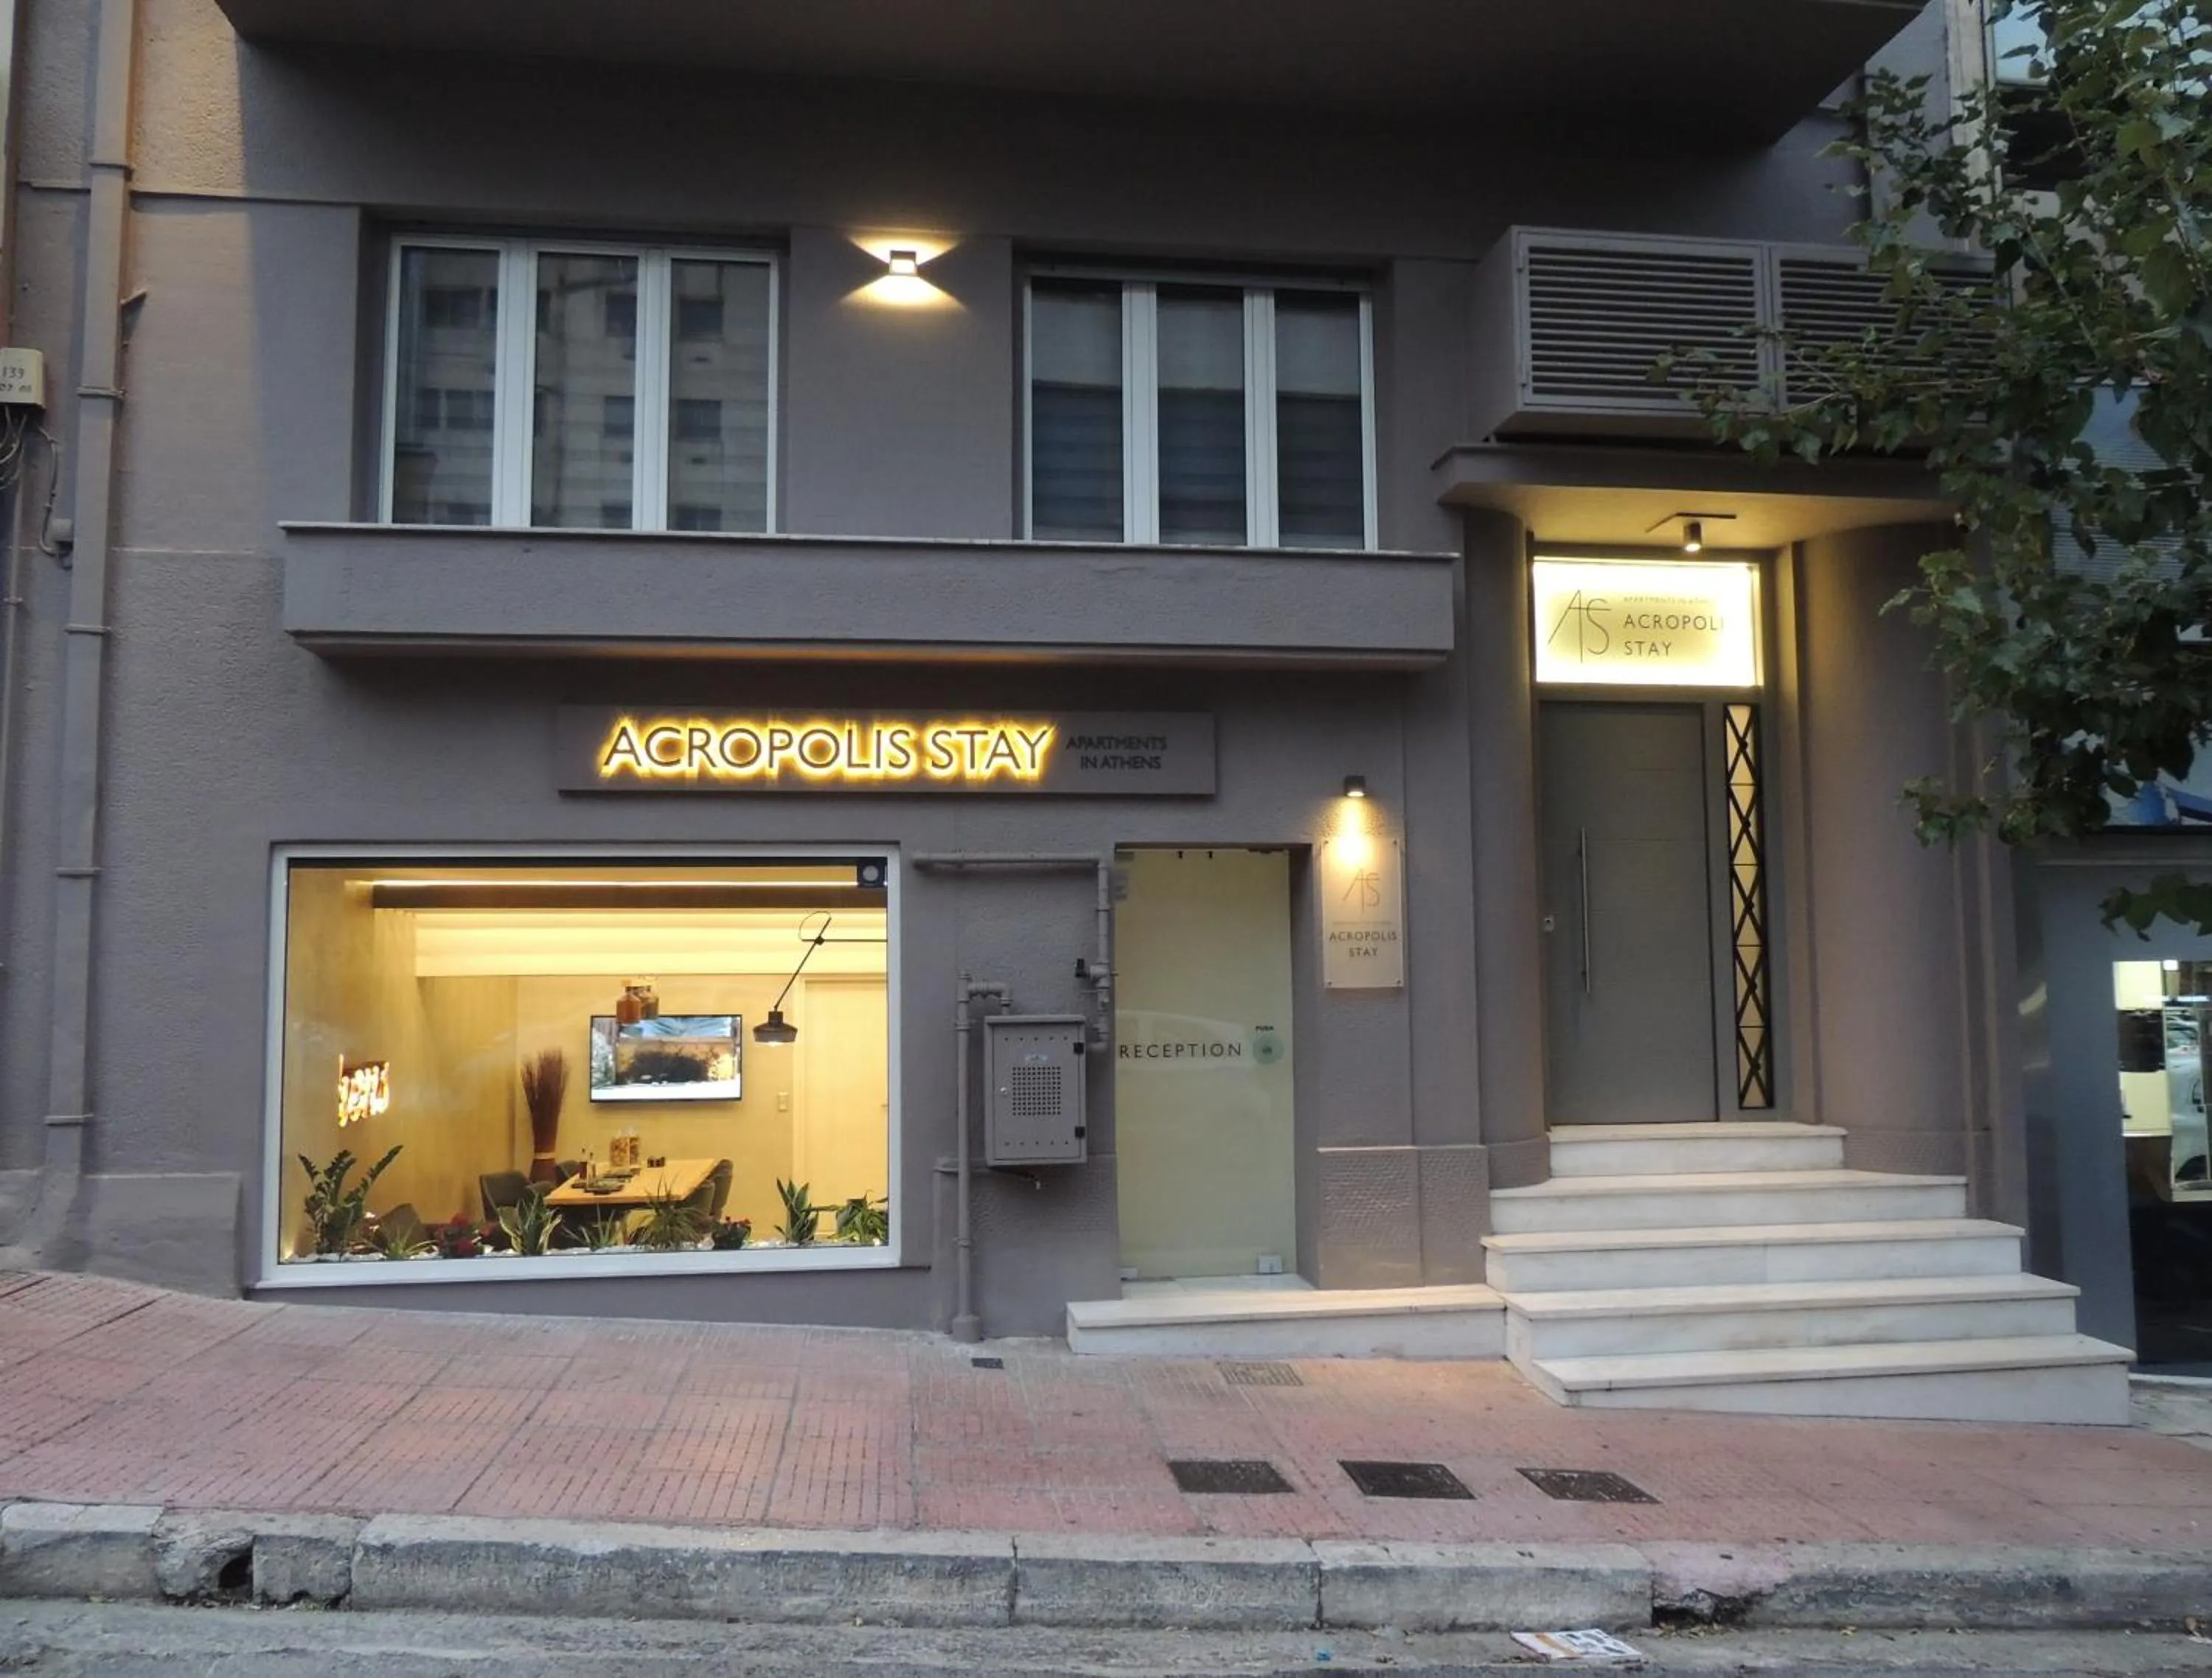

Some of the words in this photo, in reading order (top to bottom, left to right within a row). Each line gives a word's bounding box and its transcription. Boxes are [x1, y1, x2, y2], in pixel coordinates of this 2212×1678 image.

[1623, 613, 1725, 631] ACROPOLI
[1624, 641, 1672, 657] STAY
[604, 726, 911, 770] ACROPOLIS
[931, 730, 1048, 770] STAY
[1066, 735, 1167, 751] APARTMENTS
[1080, 754, 1098, 770] IN
[1100, 754, 1162, 770] ATHENS
[1329, 931, 1397, 942] ACROPOLIS
[1348, 947, 1378, 957] STAY
[1119, 1043, 1242, 1059] RECEPTION
